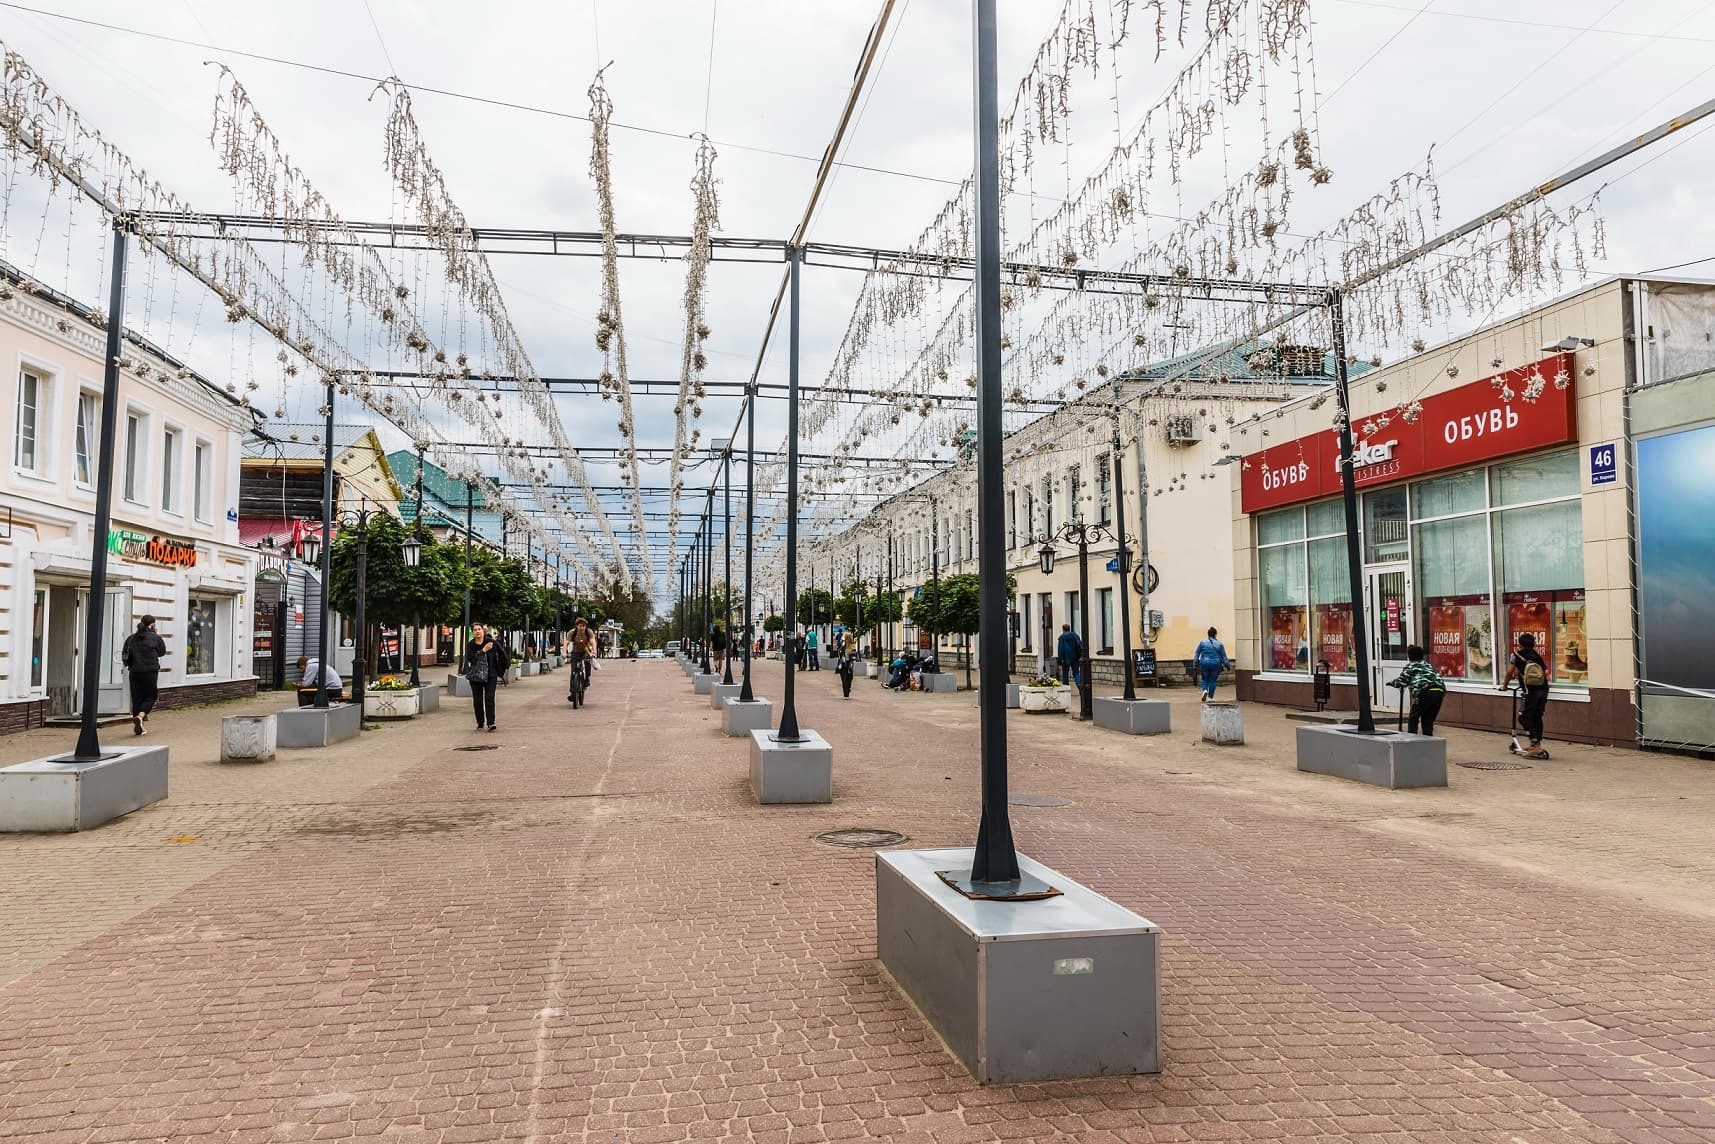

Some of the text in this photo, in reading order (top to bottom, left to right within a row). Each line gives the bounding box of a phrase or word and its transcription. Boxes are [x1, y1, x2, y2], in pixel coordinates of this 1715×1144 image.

[1444, 405, 1519, 444] ОБУВЬ
[1594, 450, 1612, 467] 46
[1263, 463, 1308, 491] ОБУВЬ
[150, 540, 197, 568] ПОДАРКИ
[1434, 631, 1460, 645] НОВАЯ
[1513, 631, 1546, 646] НАЯ
